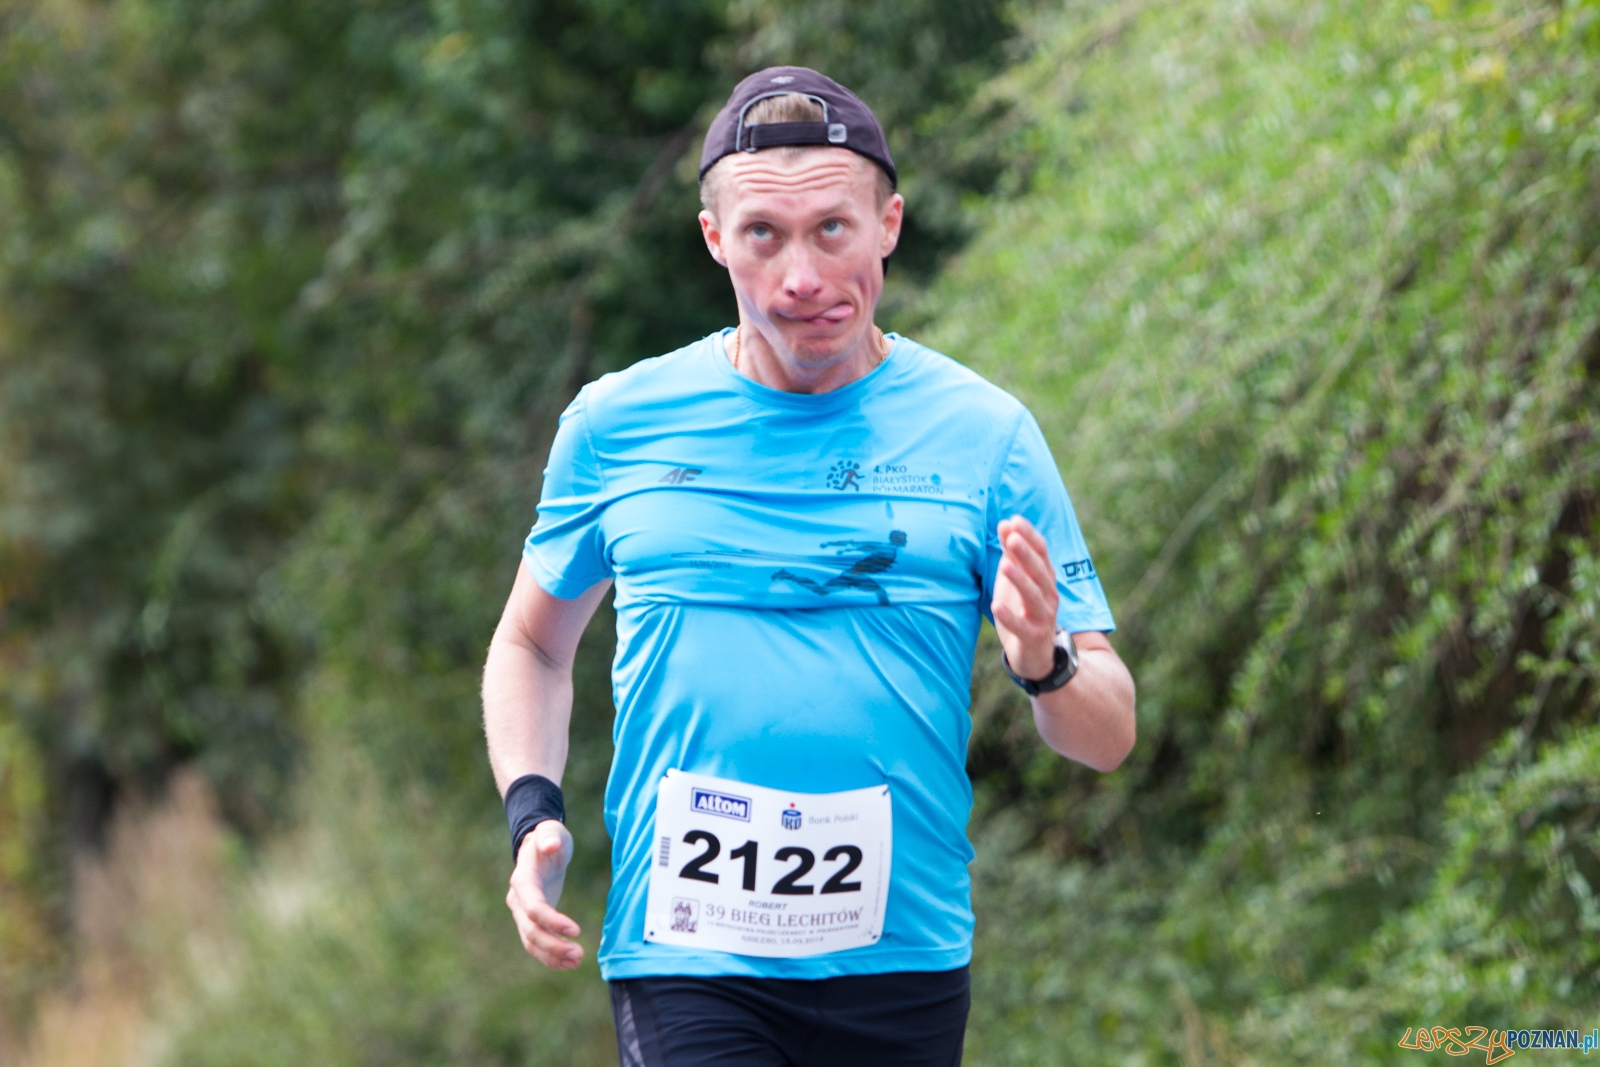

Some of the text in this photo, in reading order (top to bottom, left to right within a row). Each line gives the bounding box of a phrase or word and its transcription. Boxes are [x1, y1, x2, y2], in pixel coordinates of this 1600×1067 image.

[873, 465, 907, 474] 4. PKO
[873, 475, 927, 484] BIAŁYSTOK
[808, 815, 831, 825] Bank
[834, 812, 859, 824] Polski
[678, 829, 863, 896] 2122
[748, 900, 787, 910] ROBERT
[705, 903, 864, 927] 39 BIEG LECHITÓW
